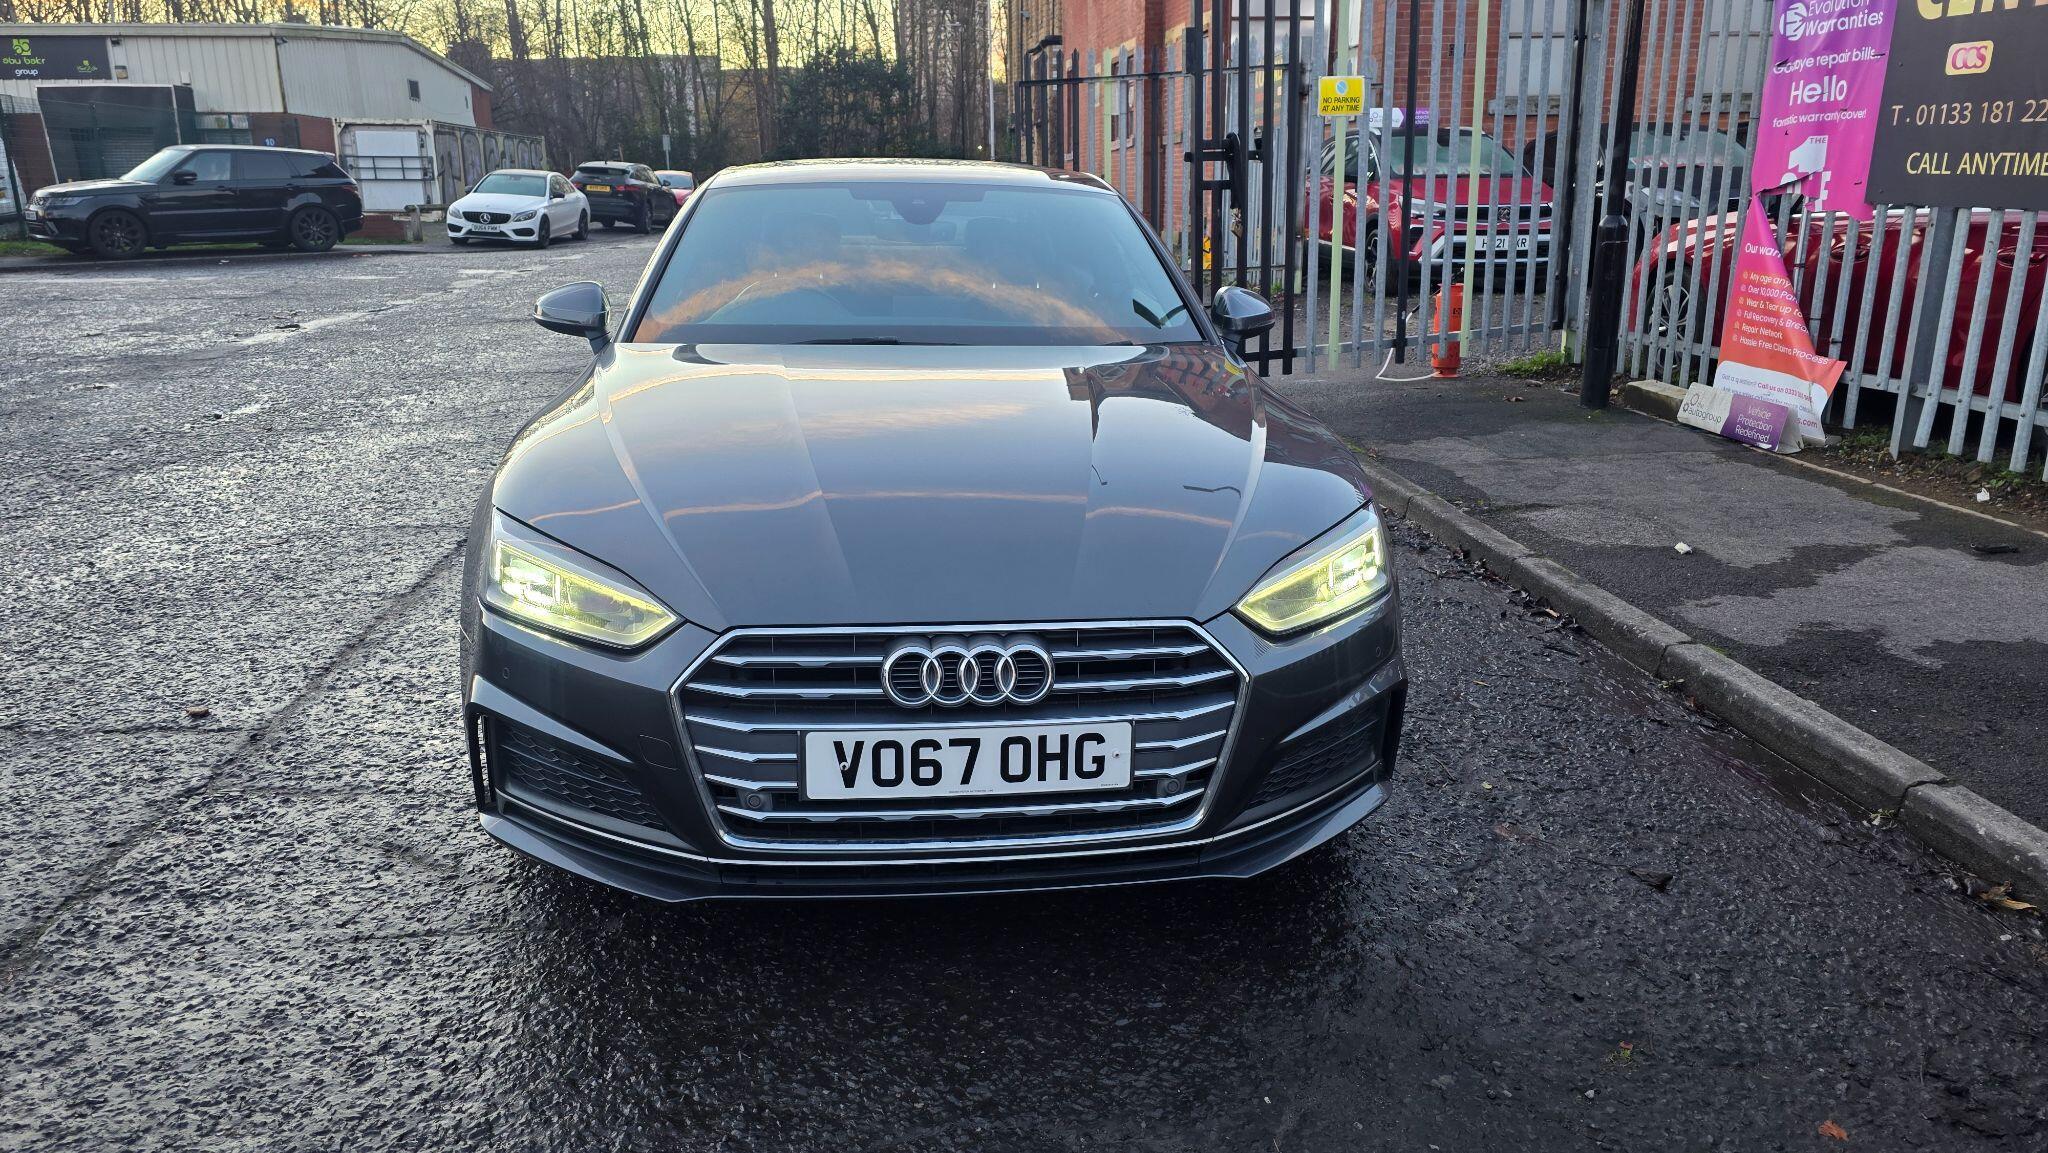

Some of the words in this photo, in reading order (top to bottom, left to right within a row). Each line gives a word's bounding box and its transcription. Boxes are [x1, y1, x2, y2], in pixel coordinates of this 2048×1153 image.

[1805, 9, 1884, 36] Warranties
[23, 56, 46, 65] bakr
[1816, 50, 1851, 68] repair
[1951, 45, 1988, 70] CCS
[15, 68, 39, 77] group
[1789, 75, 1847, 106] Hello
[1322, 104, 1330, 112] AT
[1331, 104, 1344, 112] ANY
[1345, 104, 1360, 112] TIME
[1915, 102, 1973, 126] 01133
[1980, 100, 2014, 124] 181
[1906, 151, 1951, 175] CALL
[1956, 152, 2048, 177] ANYTIME
[1745, 242, 1758, 254] Our
[1750, 272, 1759, 283] Any
[1760, 275, 1772, 285] age
[1773, 277, 1791, 288] any
[1760, 287, 1779, 298] 10,000
[1746, 298, 1758, 308] Wear
[1766, 302, 1778, 311] Tear
[1780, 306, 1792, 314] up
[1753, 312, 1778, 326] Recovery
[1742, 322, 1759, 333] Repair
[1760, 328, 1783, 340] Network
[1740, 335, 1757, 347] Hassle
[1759, 339, 1772, 350] Free
[1792, 348, 1829, 365] Process
[1757, 382, 1769, 390] Call
[1748, 405, 1772, 420] Vehicle
[1737, 414, 1773, 432] Protection
[1735, 424, 1770, 443] Redefined
[833, 737, 981, 788] VO67
[1000, 732, 1106, 783] OHG
